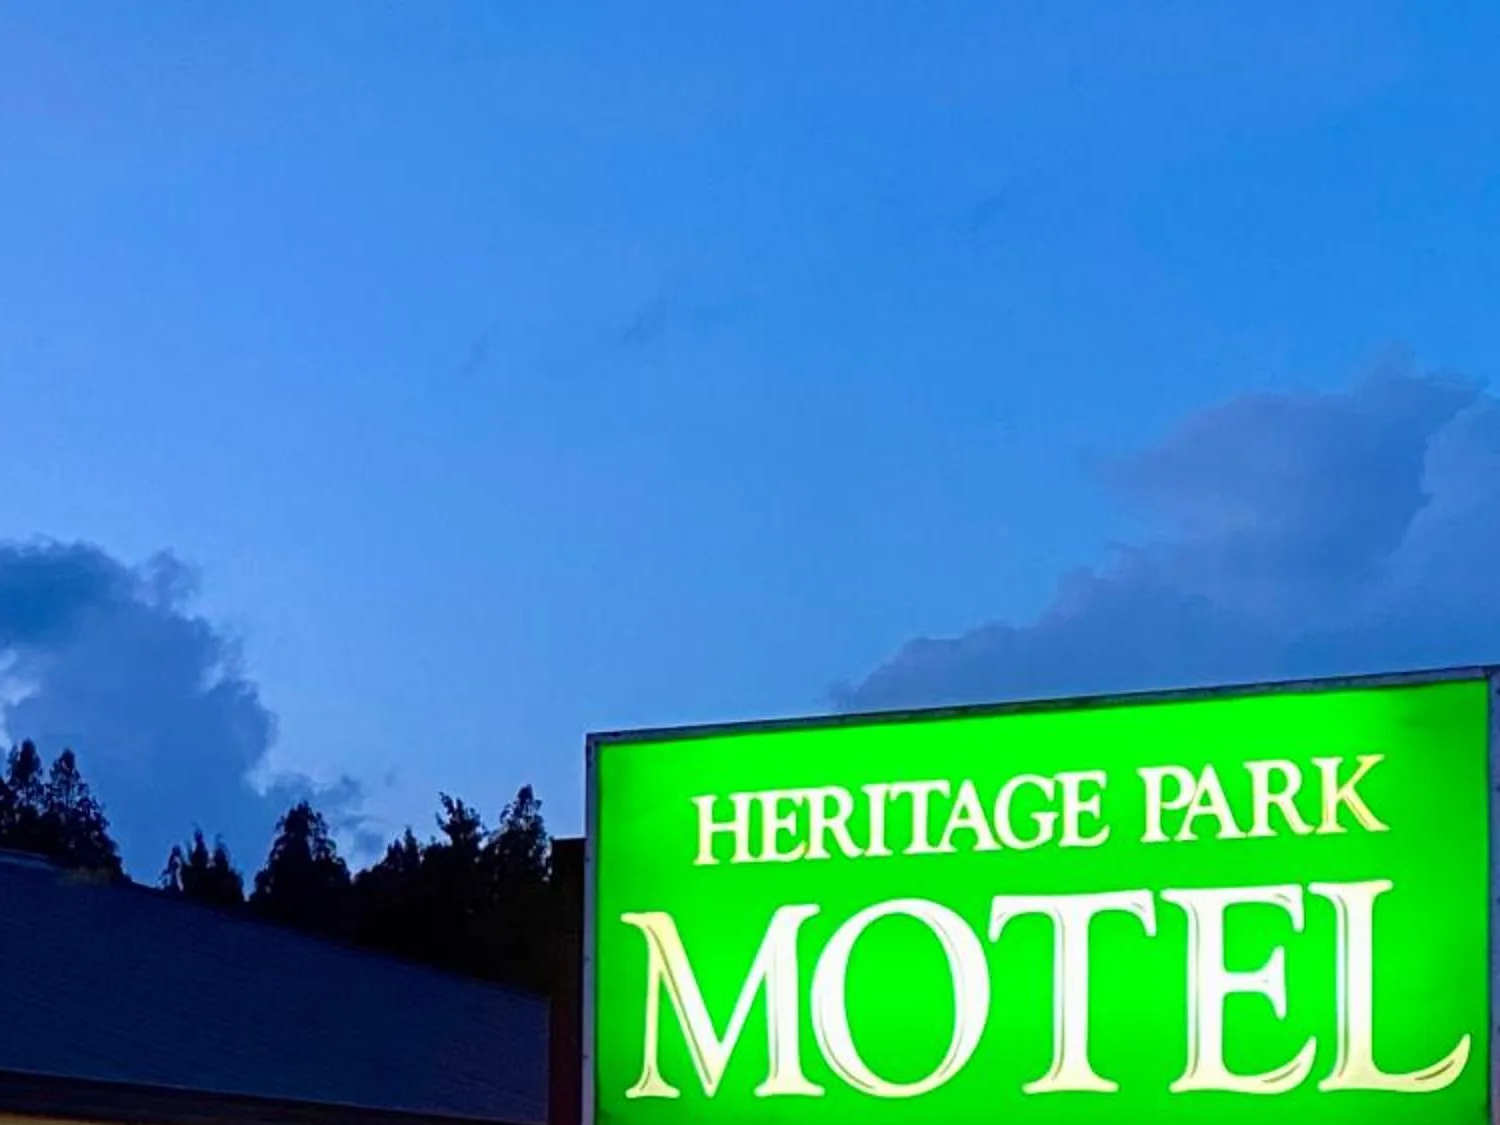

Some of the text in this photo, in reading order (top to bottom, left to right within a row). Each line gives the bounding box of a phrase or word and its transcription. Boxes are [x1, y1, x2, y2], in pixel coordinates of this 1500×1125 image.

[691, 754, 1389, 866] HERITAGE PARK
[620, 879, 1472, 1100] MOTEL
